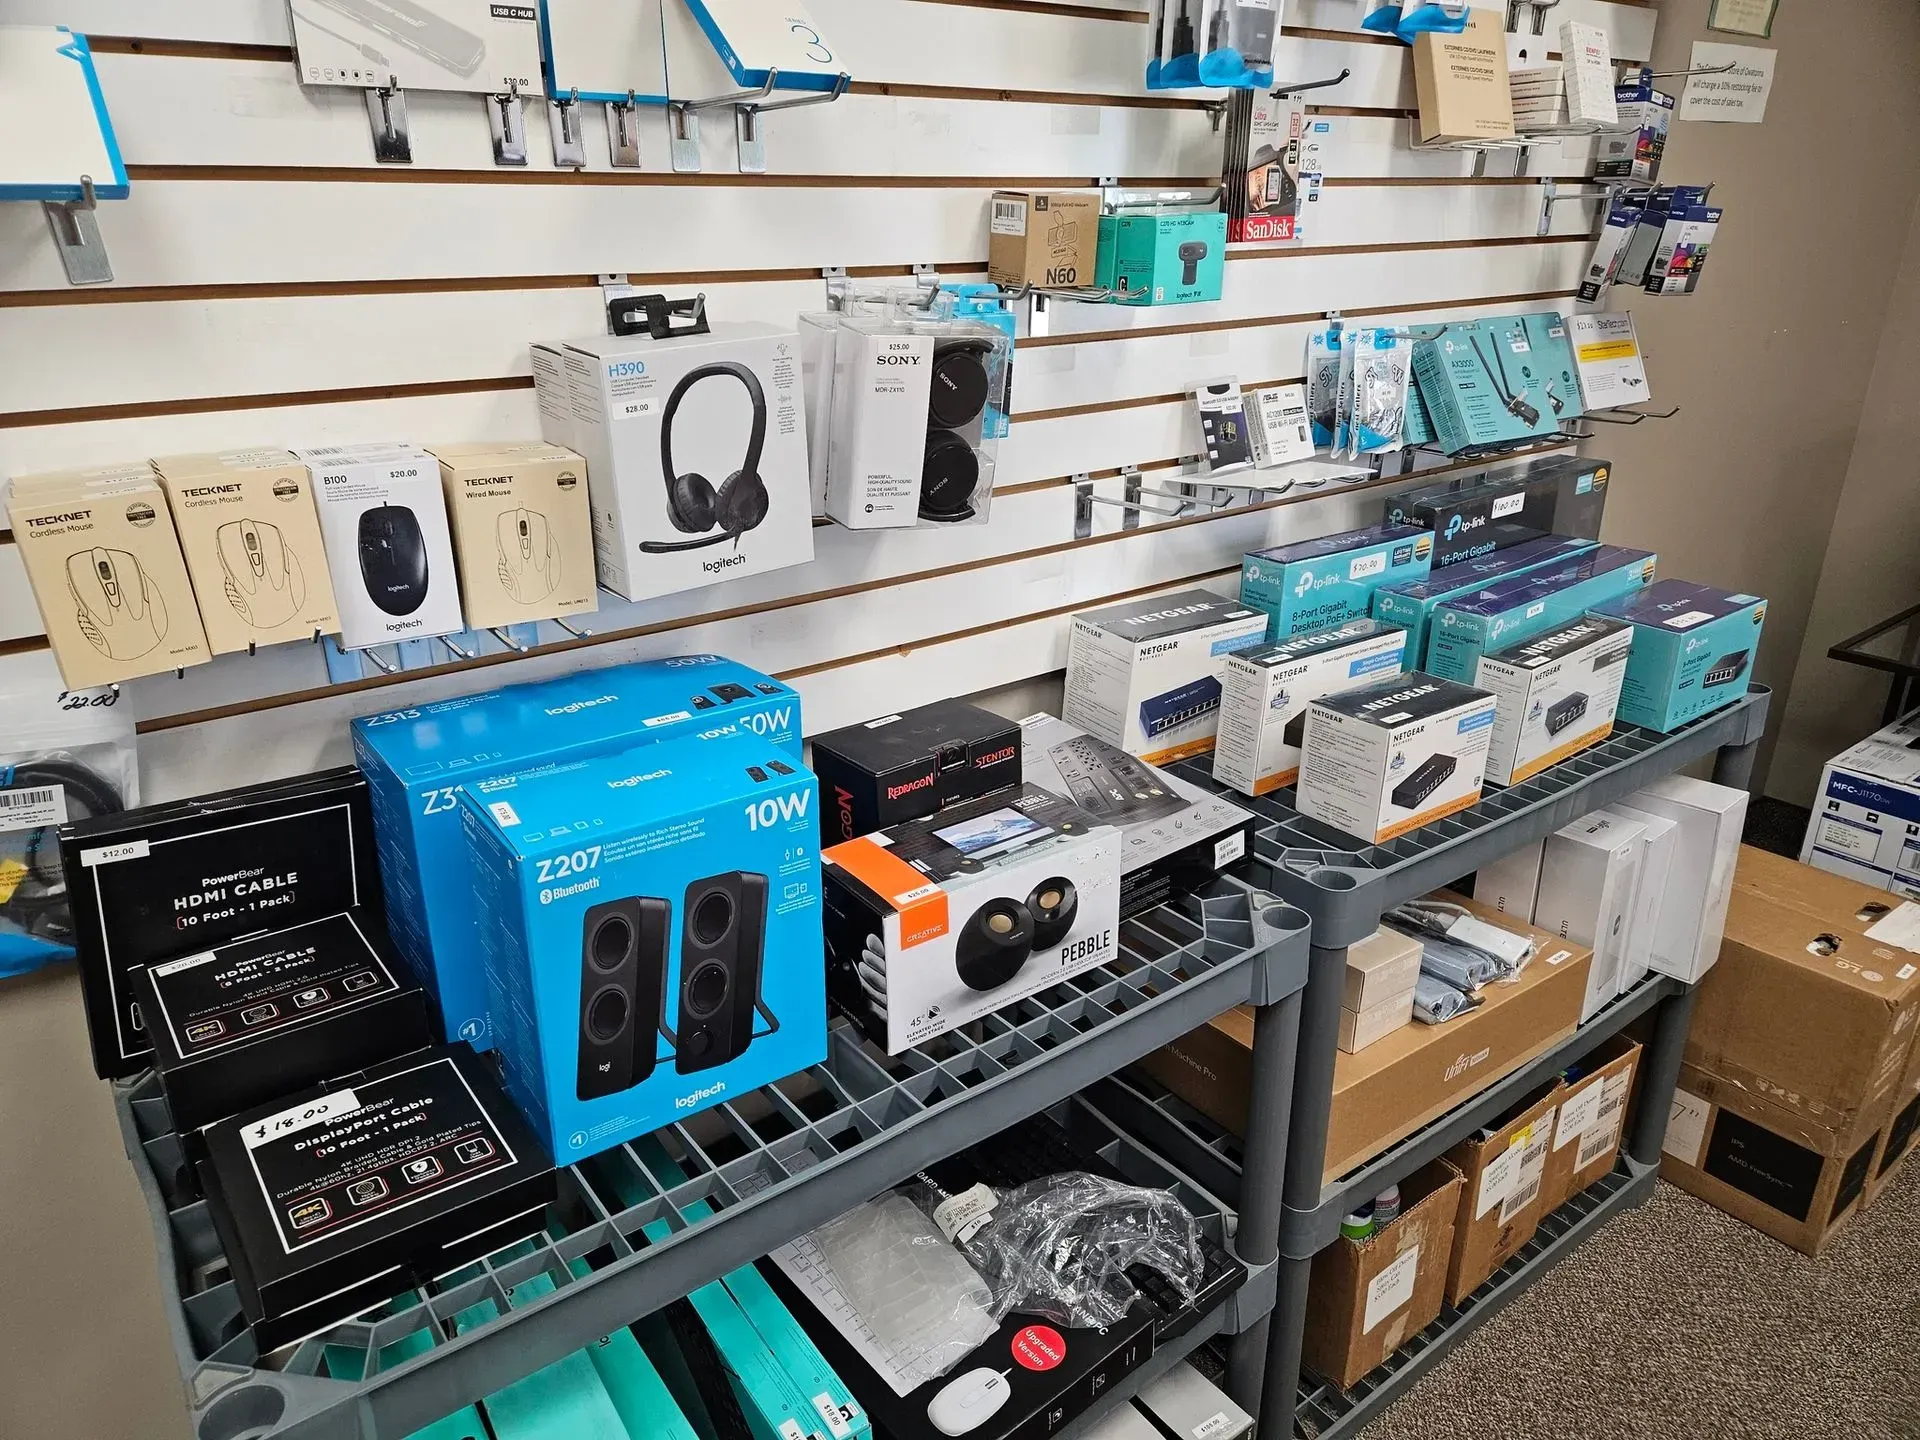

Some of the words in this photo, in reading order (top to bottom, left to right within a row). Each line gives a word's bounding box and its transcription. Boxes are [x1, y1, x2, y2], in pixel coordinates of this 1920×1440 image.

[493, 8, 509, 16] USB
[518, 10, 534, 18] HUB
[790, 24, 833, 65] 3
[504, 77, 529, 86] $30.00
[1700, 81, 1716, 92] charge
[1617, 90, 1640, 100] brother
[1300, 158, 1317, 170] 128
[1611, 215, 1626, 223] brother
[1246, 219, 1292, 240] SanDisk
[1046, 267, 1077, 284] N60
[608, 360, 645, 378] H390
[876, 355, 920, 366] SONY
[1451, 360, 1474, 368] AX3000
[940, 372, 958, 391] SONY
[1263, 393, 1278, 401] ASUS
[1338, 382, 1346, 408] Sellers
[625, 403, 649, 414] $28.00
[1266, 410, 1283, 418] AC1200
[1268, 421, 1278, 430] USB
[1288, 417, 1306, 425] ADAPTER
[324, 475, 347, 485] B100
[390, 469, 418, 478] $20.00
[464, 475, 514, 487] TECKNET
[181, 483, 243, 498] TECKNET
[465, 491, 486, 500] Wired
[488, 488, 512, 498] Mouse
[930, 478, 949, 496] SONY
[184, 498, 218, 508] Cordless
[218, 494, 244, 505] Mouse
[26, 510, 92, 528] TECKNET
[1402, 515, 1425, 527] tp-link
[1461, 515, 1486, 533] tp-link
[30, 528, 66, 539] Cordless
[66, 522, 94, 534] Mouse
[1440, 549, 1469, 566] 16-Port
[1469, 541, 1497, 556] Gigabit
[702, 554, 747, 574] logitech
[387, 582, 410, 592] logitech
[1260, 574, 1281, 585] tp-link
[1313, 574, 1340, 588] tp-link
[1124, 602, 1215, 627] NETGEAR
[1292, 605, 1318, 622] 8-Port
[1319, 600, 1348, 615] Gigabit
[1394, 605, 1415, 616] tp-link
[386, 619, 423, 633] logitech
[1075, 622, 1102, 639] NETGEAR
[1291, 618, 1325, 634] Desktop
[1326, 612, 1346, 625] PoE+
[1456, 620, 1480, 631] tp-link
[1275, 628, 1362, 653] NETGEAR
[1440, 631, 1460, 640] 16-Port
[1460, 636, 1480, 645] Gigabit
[1520, 624, 1597, 657] NETGEAR
[1140, 641, 1180, 656] NETGEAR
[665, 655, 718, 669] 50W
[1228, 660, 1258, 675] NETGEAR
[1484, 662, 1516, 677] NETGEAR
[1273, 664, 1310, 682] NETGEAR
[1534, 664, 1562, 682] NETGEAR
[58, 692, 118, 711] $22.00
[544, 694, 619, 716] logitech
[1362, 683, 1440, 712] NETGEAR
[364, 708, 422, 727] Z313
[1312, 708, 1344, 724] NETGEAR
[696, 724, 738, 742] 10W
[1393, 725, 1426, 742] NETGEAR
[974, 746, 1016, 768] STENTOR
[476, 776, 517, 790] Z207
[607, 769, 673, 789] logitech
[887, 772, 934, 800] REDRAGON
[744, 788, 811, 832] 10W
[602, 841, 620, 850] Listen
[621, 833, 649, 845] wirelessly
[656, 828, 668, 836] Rich
[669, 823, 687, 832] Stereo
[687, 817, 705, 827] Sound
[102, 846, 134, 859] $12.00
[603, 846, 626, 857] Écoutez
[647, 836, 665, 845] stéréo
[665, 832, 678, 840] riche
[604, 854, 624, 863] Sonido
[624, 848, 647, 858] estéreo
[646, 839, 680, 852] inalámbrico
[680, 831, 706, 842] detallado
[536, 845, 602, 883] Z207
[202, 866, 265, 888] PowerBear
[174, 888, 228, 911] HDMI
[234, 872, 298, 896] CABLE
[553, 877, 600, 900] Bluetooth
[203, 908, 235, 923] Foot
[249, 902, 256, 911] 1
[906, 924, 944, 943] CREATIVE
[1060, 929, 1112, 966] PEBBLE
[214, 963, 258, 982] HDMI
[262, 947, 316, 968] CABLE
[235, 950, 286, 967] PowerBear
[1834, 956, 1864, 974] LG
[236, 972, 262, 986] Foot
[189, 1005, 221, 1018] Durable
[906, 1023, 932, 1040] ELEVATED
[932, 1018, 946, 1029] WIDE
[908, 1032, 928, 1044] SOUND
[928, 1024, 945, 1036] STAGE
[599, 1061, 611, 1073] logi
[1171, 1045, 1202, 1072] Machine
[1203, 1066, 1217, 1081] Pro
[1443, 1054, 1470, 1082] UniFi
[674, 1080, 726, 1110] logitech
[324, 1097, 394, 1127] PowerBear
[254, 1104, 329, 1139] $18.00
[294, 1112, 387, 1151] DisplayPort
[391, 1097, 434, 1116] Cable
[340, 1133, 371, 1150] Foot
[439, 1134, 458, 1142] ARC
[1731, 1137, 1745, 1149] IPS
[376, 1143, 397, 1154] HDR
[276, 1182, 313, 1199] Durable
[314, 1171, 342, 1183] Nylon
[344, 1158, 378, 1172] Braided
[380, 1149, 405, 1160] Cable
[414, 1136, 436, 1147] Gold
[436, 1126, 462, 1138] Plated
[463, 1120, 481, 1130] Tips
[1728, 1153, 1748, 1168] AMD
[293, 1202, 322, 1219] 4K
[1018, 1341, 1046, 1367] Version
[1023, 1328, 1061, 1362] Upgraded
[824, 1404, 841, 1426] $18.00
